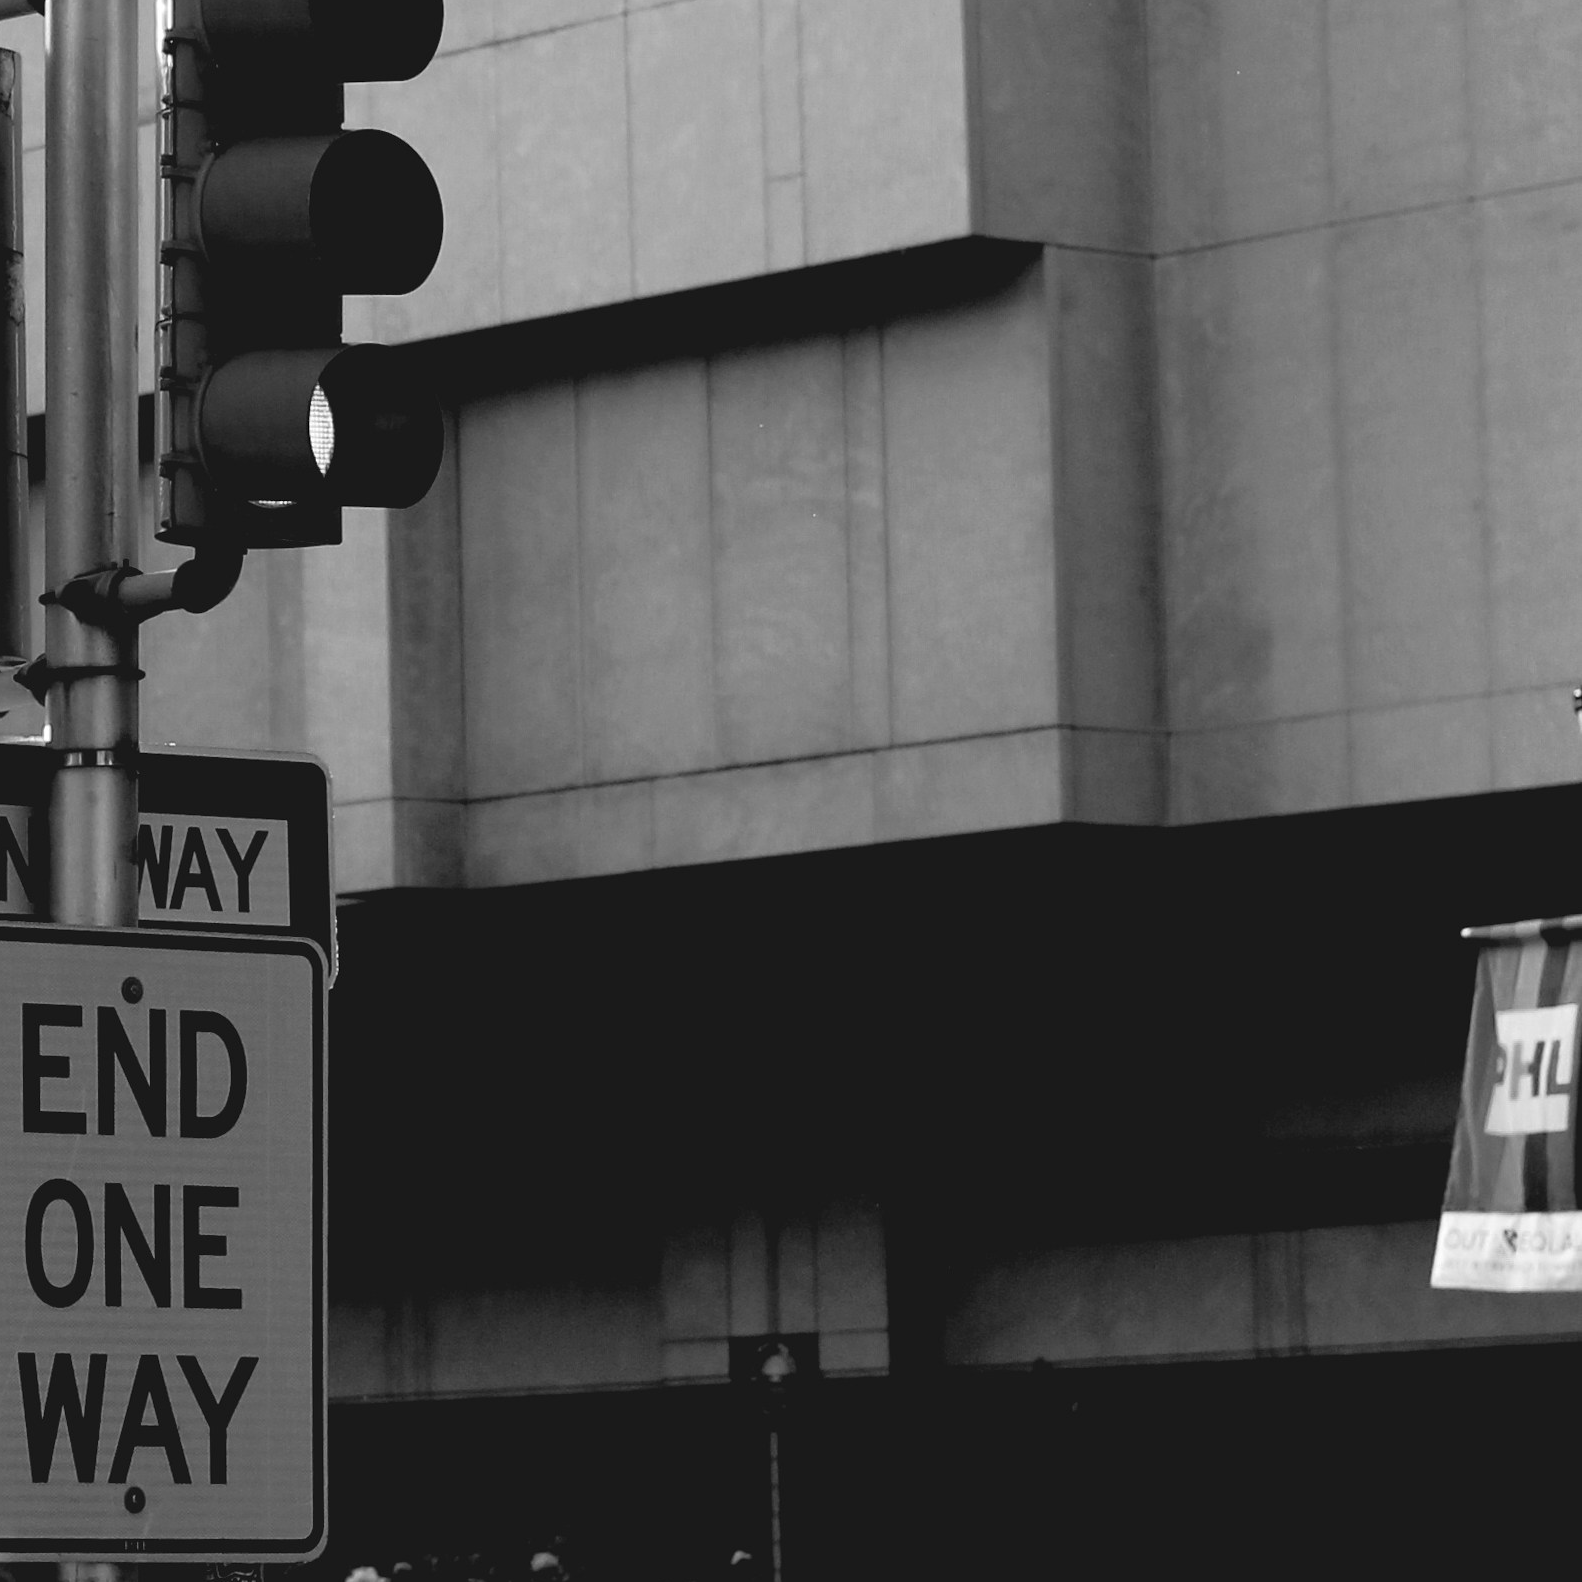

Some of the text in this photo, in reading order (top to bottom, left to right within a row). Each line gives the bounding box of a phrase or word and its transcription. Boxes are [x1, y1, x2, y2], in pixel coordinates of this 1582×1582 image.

[136, 823, 269, 913] WAY
[22, 1003, 248, 1138] END
[24, 1178, 242, 1310] ONE
[18, 1352, 259, 1485] WAY
